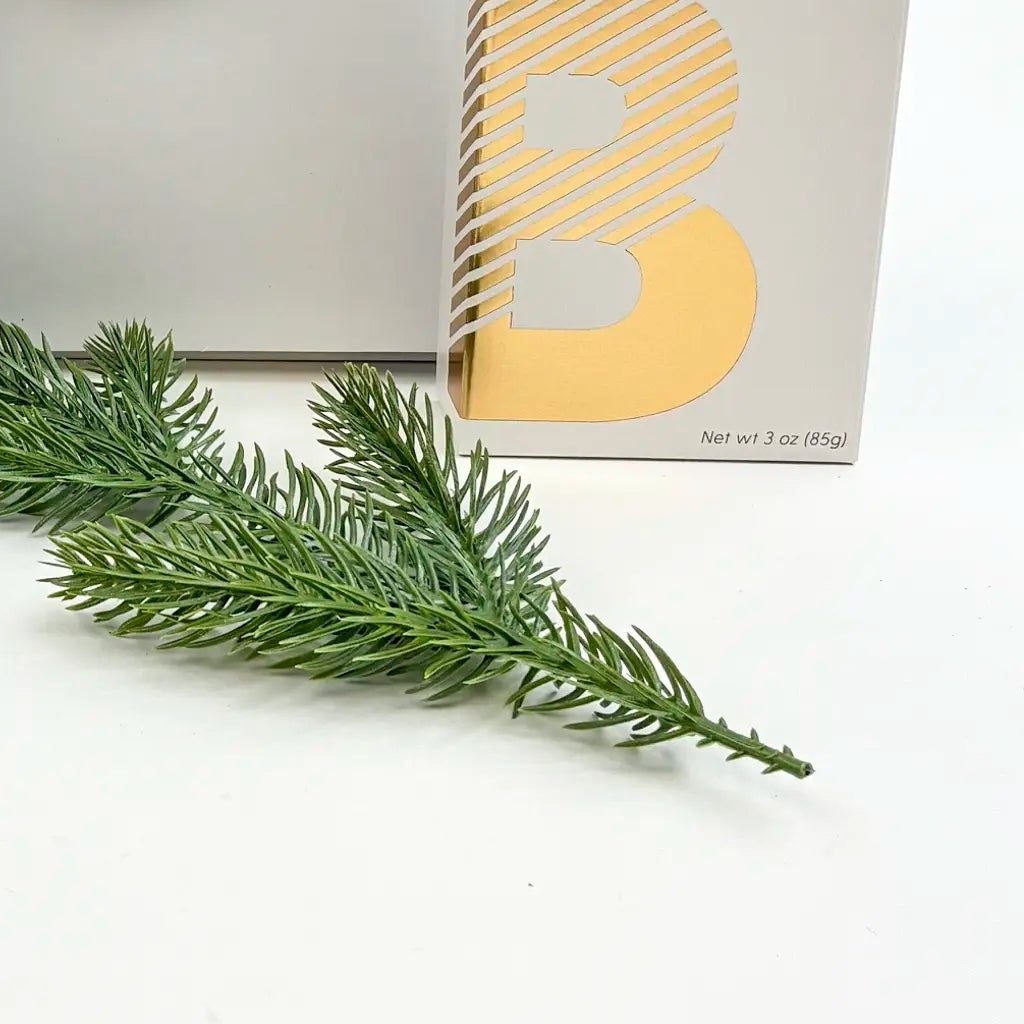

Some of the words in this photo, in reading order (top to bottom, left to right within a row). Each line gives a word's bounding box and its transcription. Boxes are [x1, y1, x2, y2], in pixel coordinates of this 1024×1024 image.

[701, 430, 730, 445] Net
[737, 433, 759, 445] wt
[763, 431, 774, 445] 3
[779, 434, 799, 446] oz
[804, 431, 848, 450] (85g)
